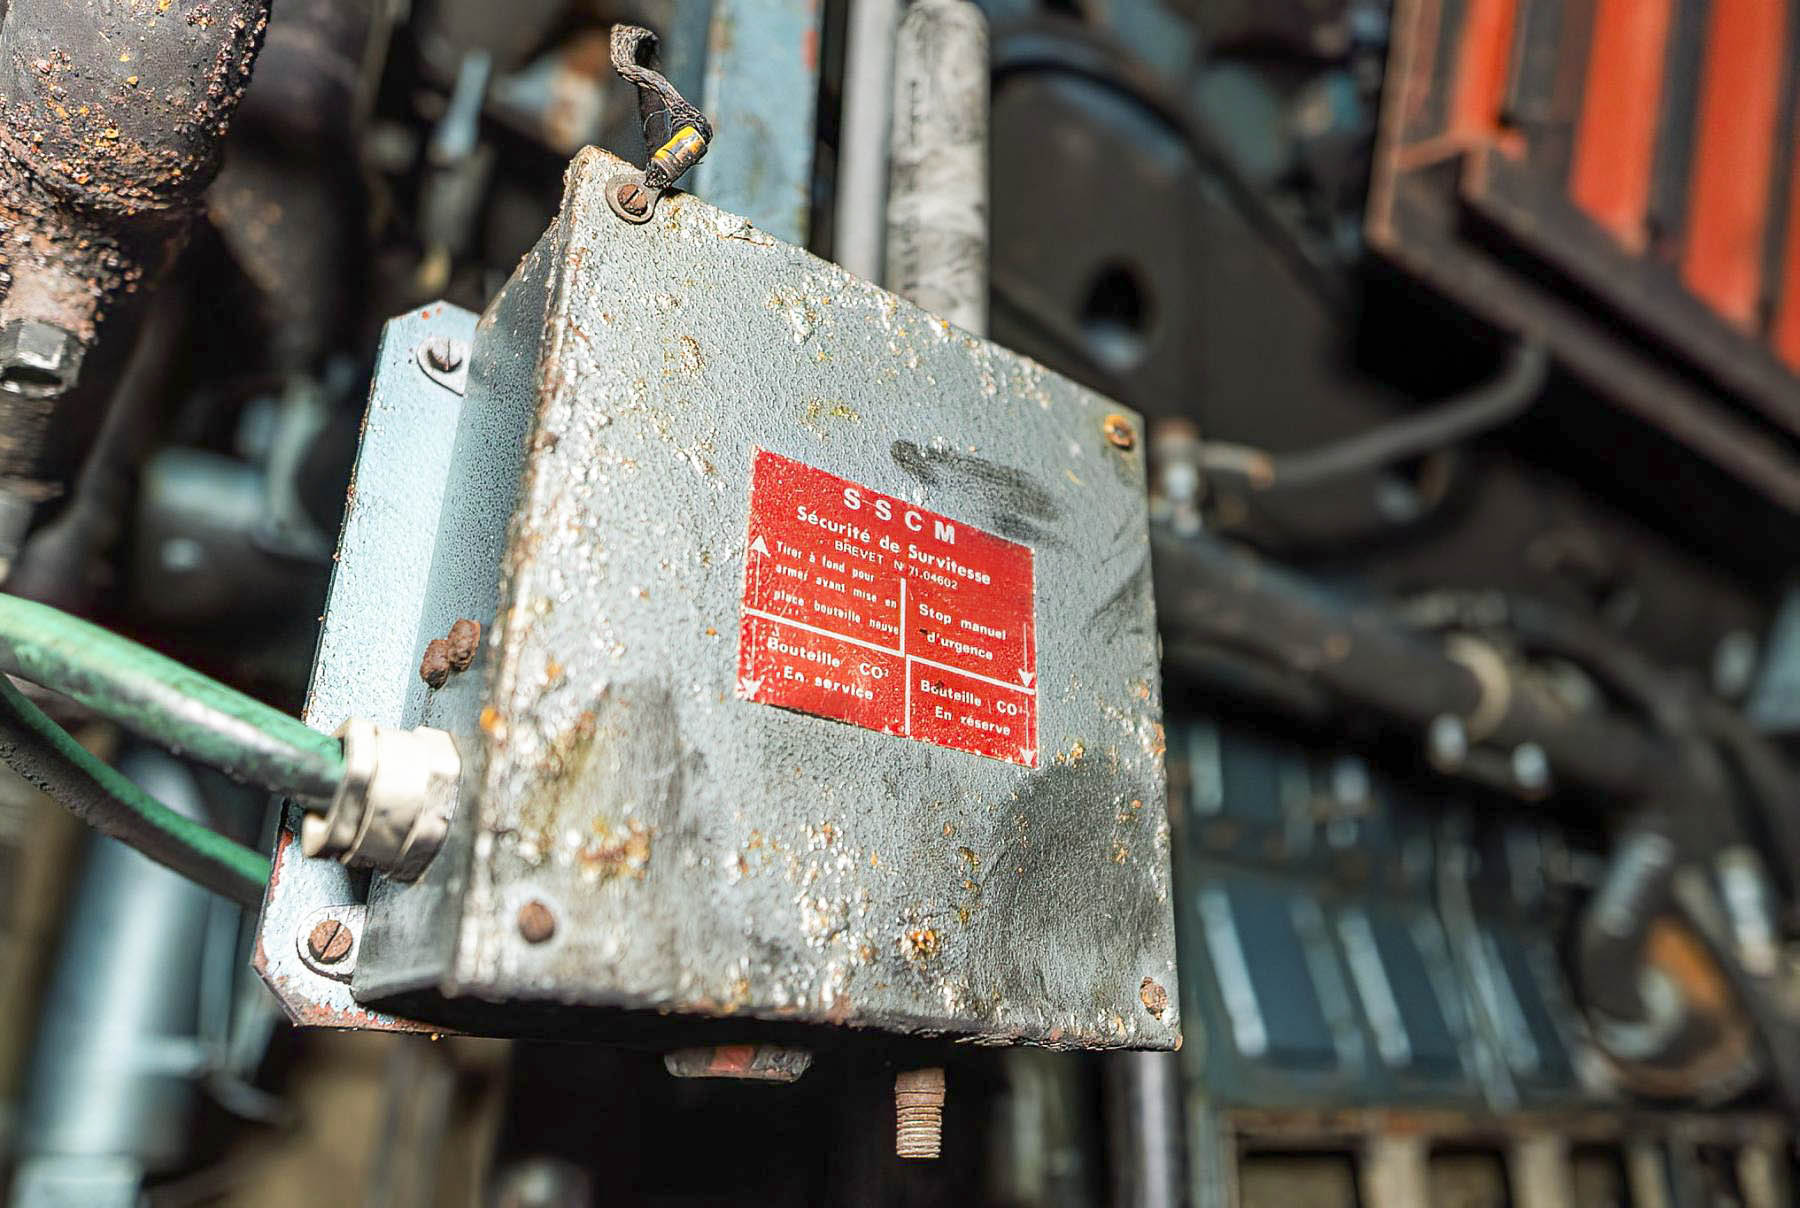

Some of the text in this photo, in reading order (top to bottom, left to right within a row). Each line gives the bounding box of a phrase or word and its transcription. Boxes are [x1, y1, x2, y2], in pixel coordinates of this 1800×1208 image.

[776, 540, 876, 583] Tirer à fond pour
[797, 505, 991, 585] Sécurité de Survitesse
[835, 540, 884, 565] BREVET
[775, 564, 897, 609] armer avant mise en
[773, 589, 899, 636] place bouteille neuve
[919, 603, 1007, 640] Stop manuel
[767, 636, 841, 667] Bouteille
[927, 631, 993, 660] d'urgence
[783, 665, 874, 700] En service
[920, 679, 982, 706] Bouteille
[935, 706, 1011, 736] En réserve
